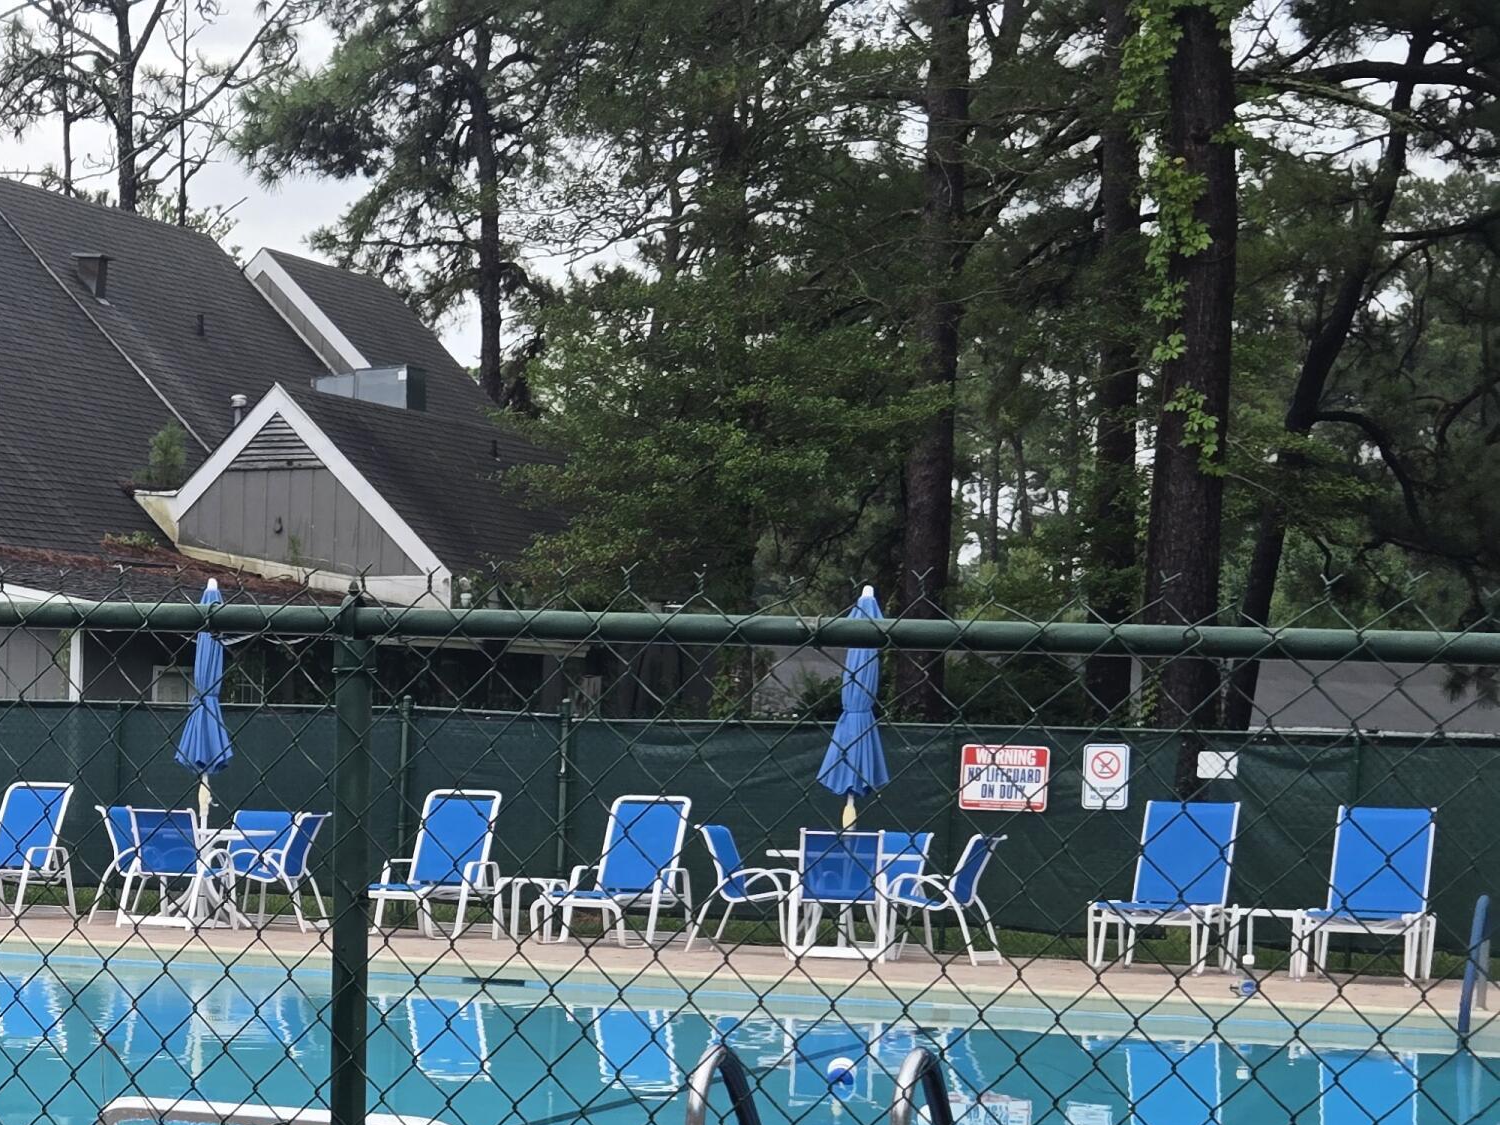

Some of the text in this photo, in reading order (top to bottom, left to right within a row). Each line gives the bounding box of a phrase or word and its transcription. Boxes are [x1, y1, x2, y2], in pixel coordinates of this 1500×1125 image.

[967, 766, 1041, 783] NO LIFEGUARD
[981, 784, 1026, 799] ON DUTY
